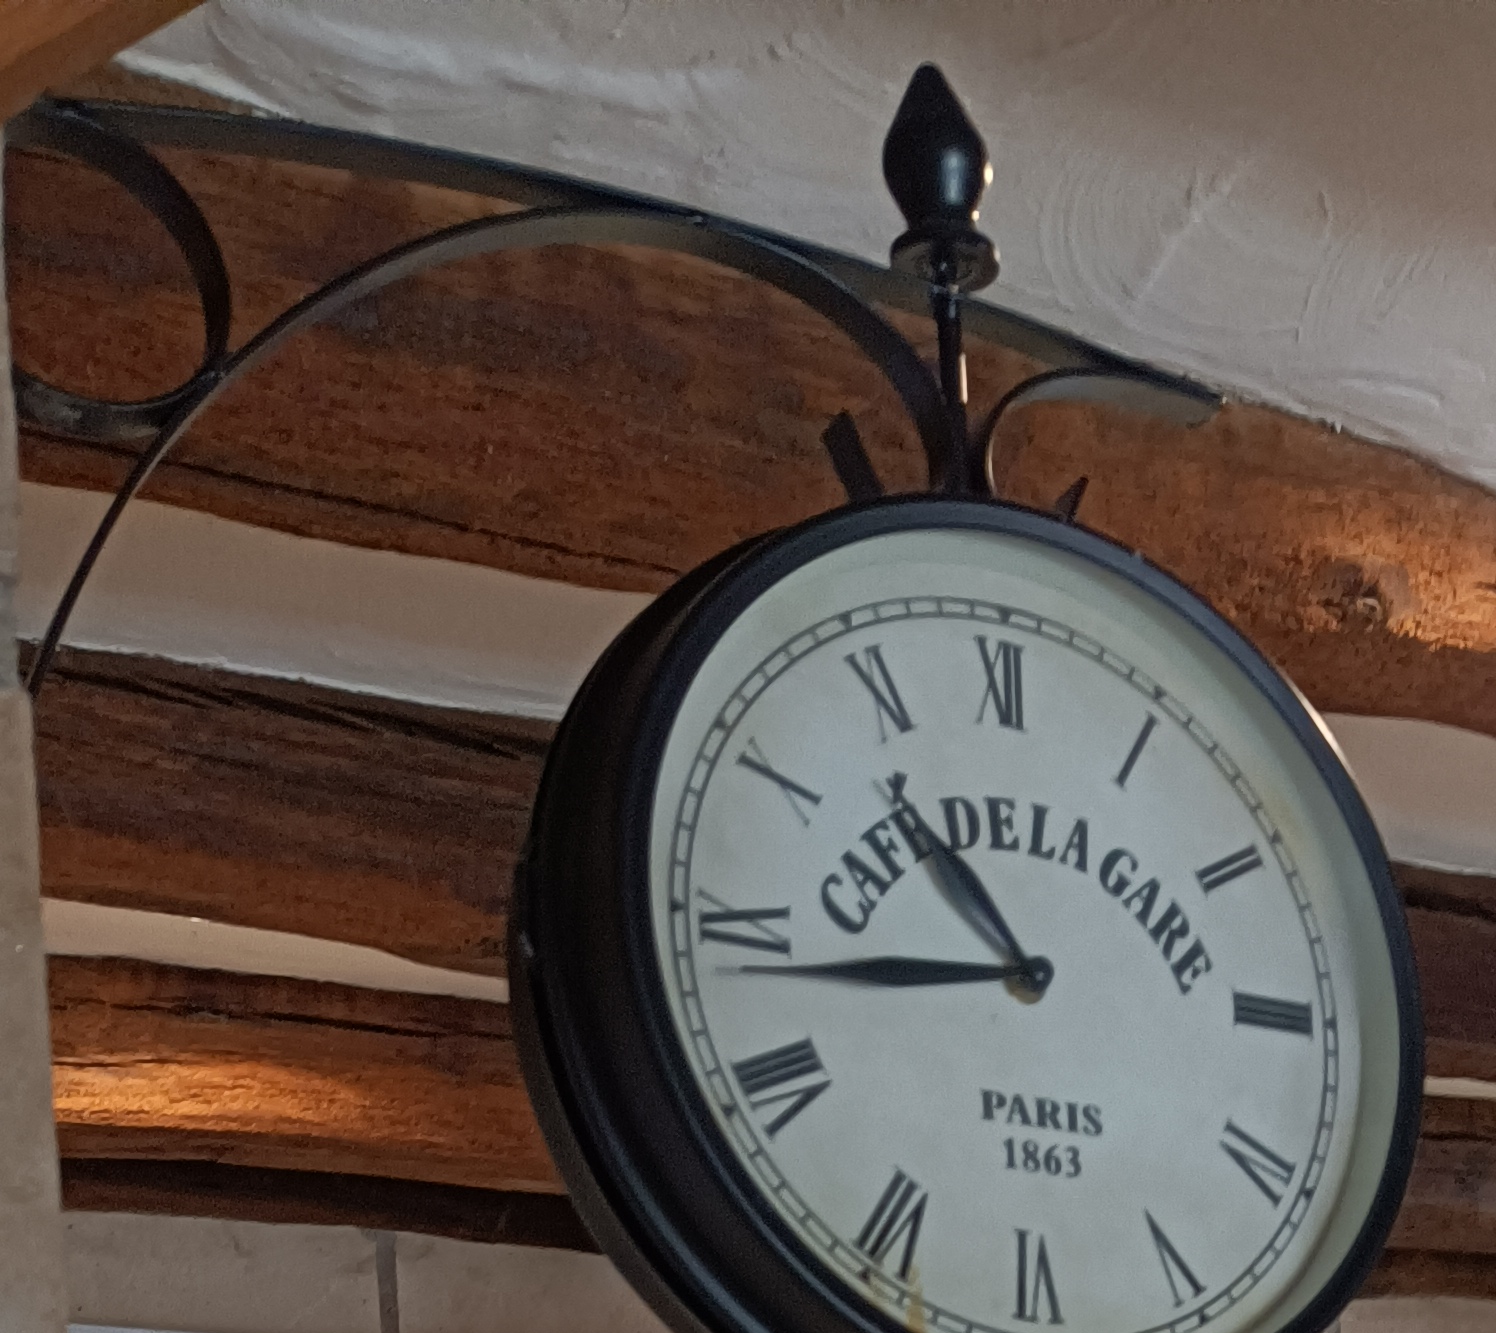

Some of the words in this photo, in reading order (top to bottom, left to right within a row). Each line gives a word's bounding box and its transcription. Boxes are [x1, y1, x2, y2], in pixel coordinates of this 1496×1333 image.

[844, 642, 914, 745] XI
[973, 633, 1026, 733] XII
[735, 735, 824, 828] X
[1113, 710, 1160, 791] I
[1195, 843, 1264, 898] II
[696, 886, 792, 960] IX
[1099, 846, 1213, 996] GARE
[729, 1036, 833, 1142] VIII
[981, 1088, 1103, 1137] PARIS
[1003, 1136, 1082, 1179] 1863
[1219, 1117, 1297, 1209] IV
[852, 1164, 929, 1282] VII
[1143, 1207, 1207, 1308] V
[1013, 1227, 1065, 1326] VI
